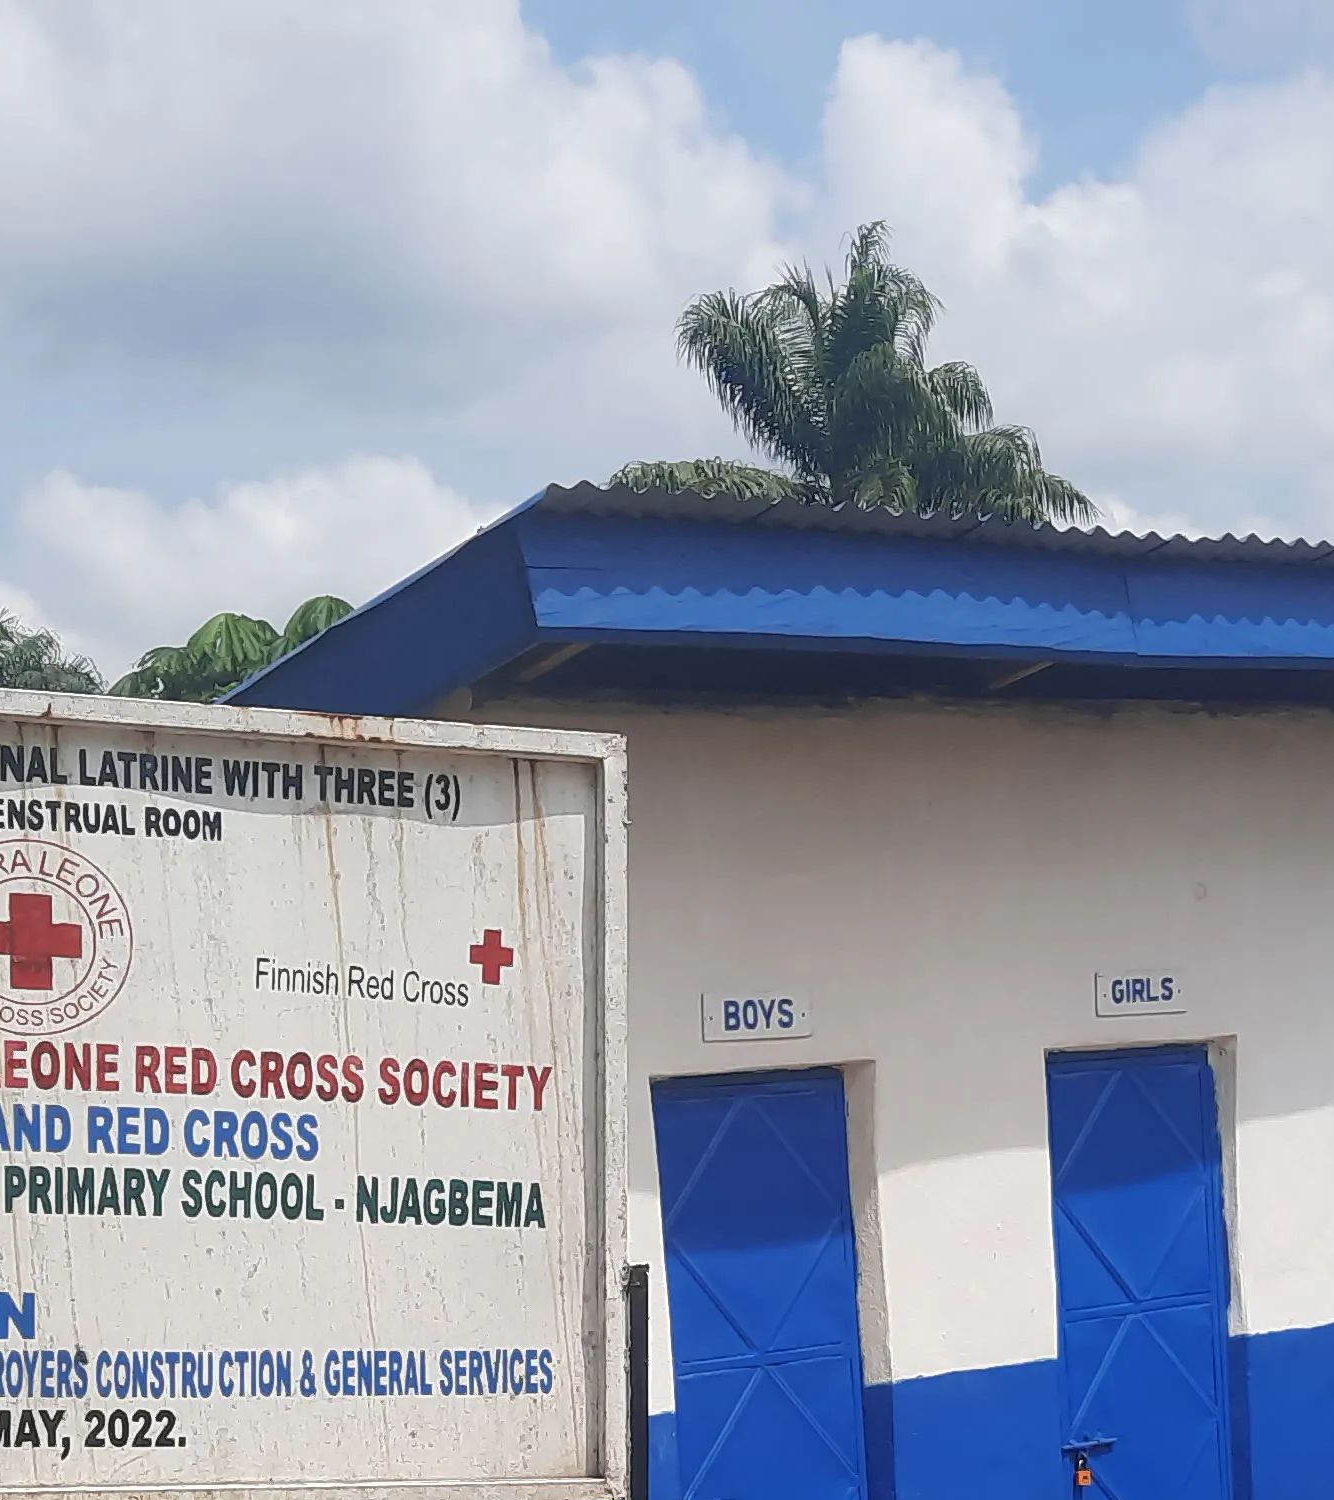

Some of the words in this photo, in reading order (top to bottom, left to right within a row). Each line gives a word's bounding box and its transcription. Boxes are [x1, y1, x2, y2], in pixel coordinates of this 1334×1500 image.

[79, 749, 212, 794] LATRINE
[314, 765, 415, 809] THREE
[425, 774, 460, 821] (3)
[145, 807, 221, 841] ROOM
[38, 850, 124, 938] LEONE
[50, 956, 118, 1025] SOCIETY
[255, 957, 338, 996] Finnish
[348, 966, 394, 1001] Red
[403, 970, 469, 1007] Cross
[1111, 977, 1175, 1005] GIRLS
[723, 998, 794, 1032] BOYS
[136, 1046, 216, 1095] RED
[231, 1050, 363, 1103] CROSS
[378, 1058, 552, 1110] SOCIETY
[88, 1106, 169, 1155] RED
[184, 1110, 318, 1161] CROSS
[5, 1166, 170, 1216] PRIMARY
[182, 1170, 324, 1220] SCHOOL
[357, 1176, 546, 1228] NJAGBEMA
[97, 1350, 291, 1399] CONSTRUCTION
[300, 1350, 316, 1397] &
[325, 1350, 432, 1396] GENERAL
[440, 1349, 552, 1396] SERVICES
[85, 1409, 186, 1447] 2022.
